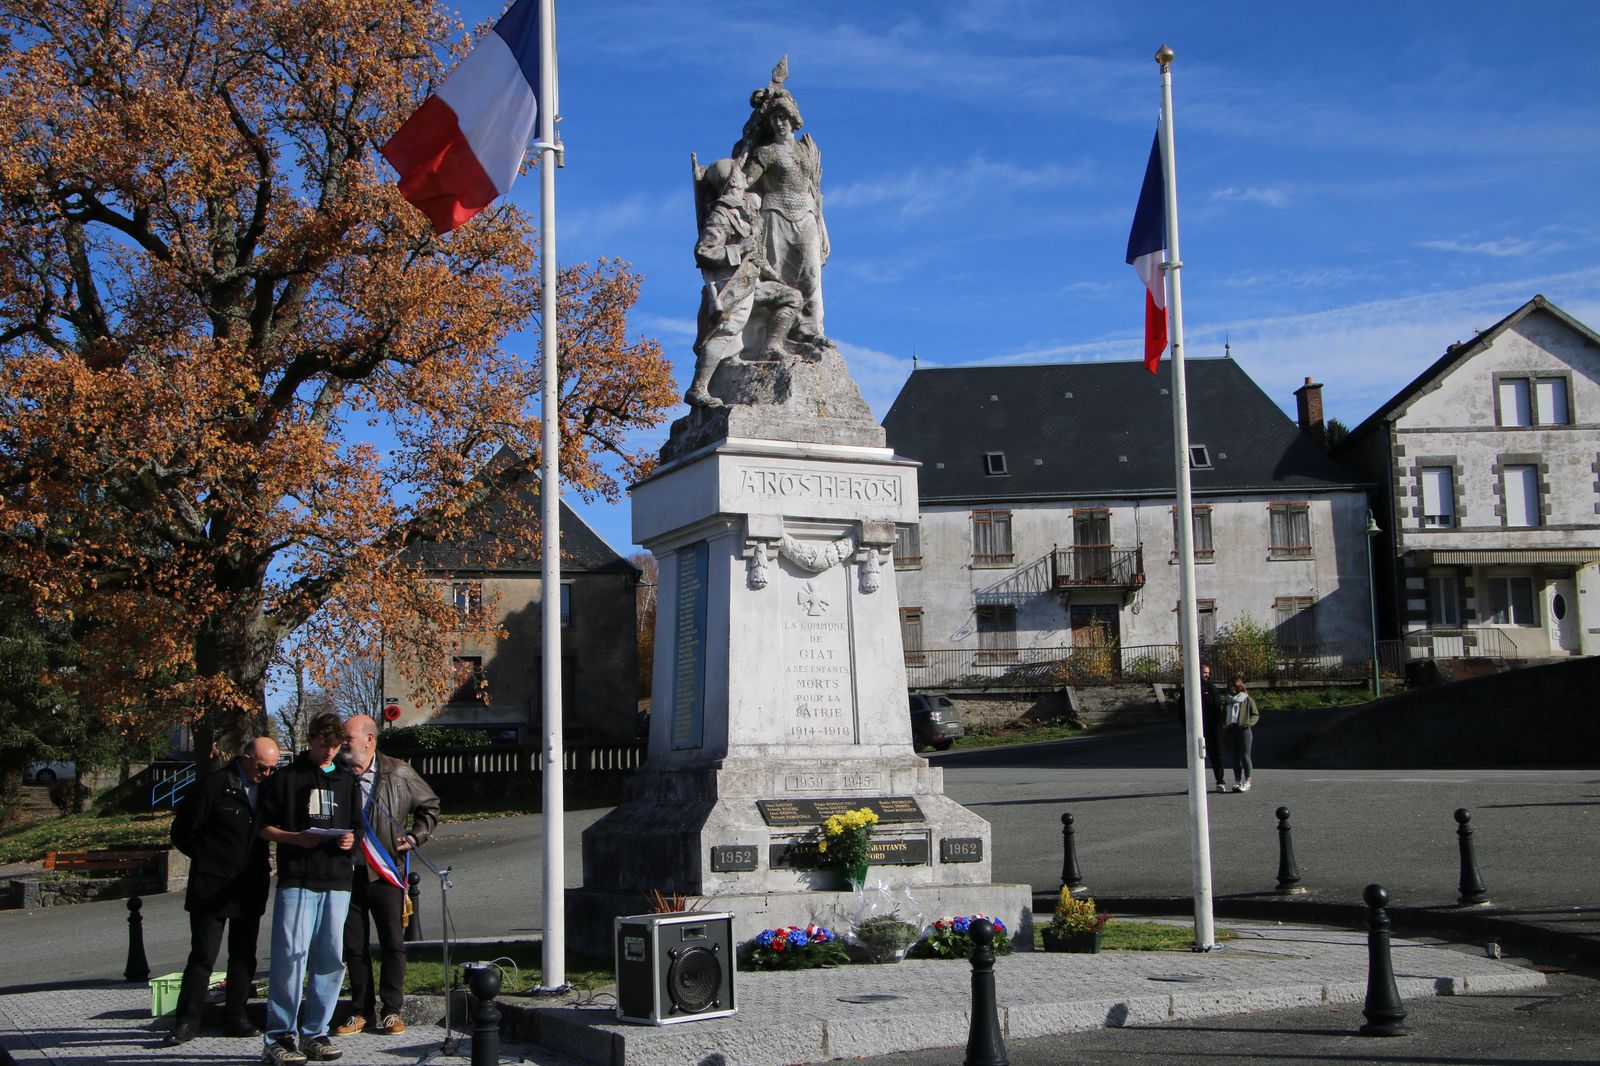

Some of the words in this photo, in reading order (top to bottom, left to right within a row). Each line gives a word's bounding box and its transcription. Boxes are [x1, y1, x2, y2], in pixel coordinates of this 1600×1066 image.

[762, 471, 812, 498] NOS
[819, 474, 896, 503] HEROS
[784, 621, 797, 630] LA
[800, 621, 846, 631] COMMUNE
[809, 635, 823, 643] DE
[799, 648, 835, 660] GIAT
[793, 665, 810, 674] SES
[810, 665, 850, 674] ENFANTS
[796, 679, 839, 689] MORTS
[795, 694, 824, 702] POUR
[828, 694, 841, 702] LA
[796, 707, 843, 718] PATRIE
[795, 776, 824, 789] 1939
[843, 775, 872, 788] 1945
[949, 842, 978, 856] 1962
[720, 850, 752, 864] 1952
